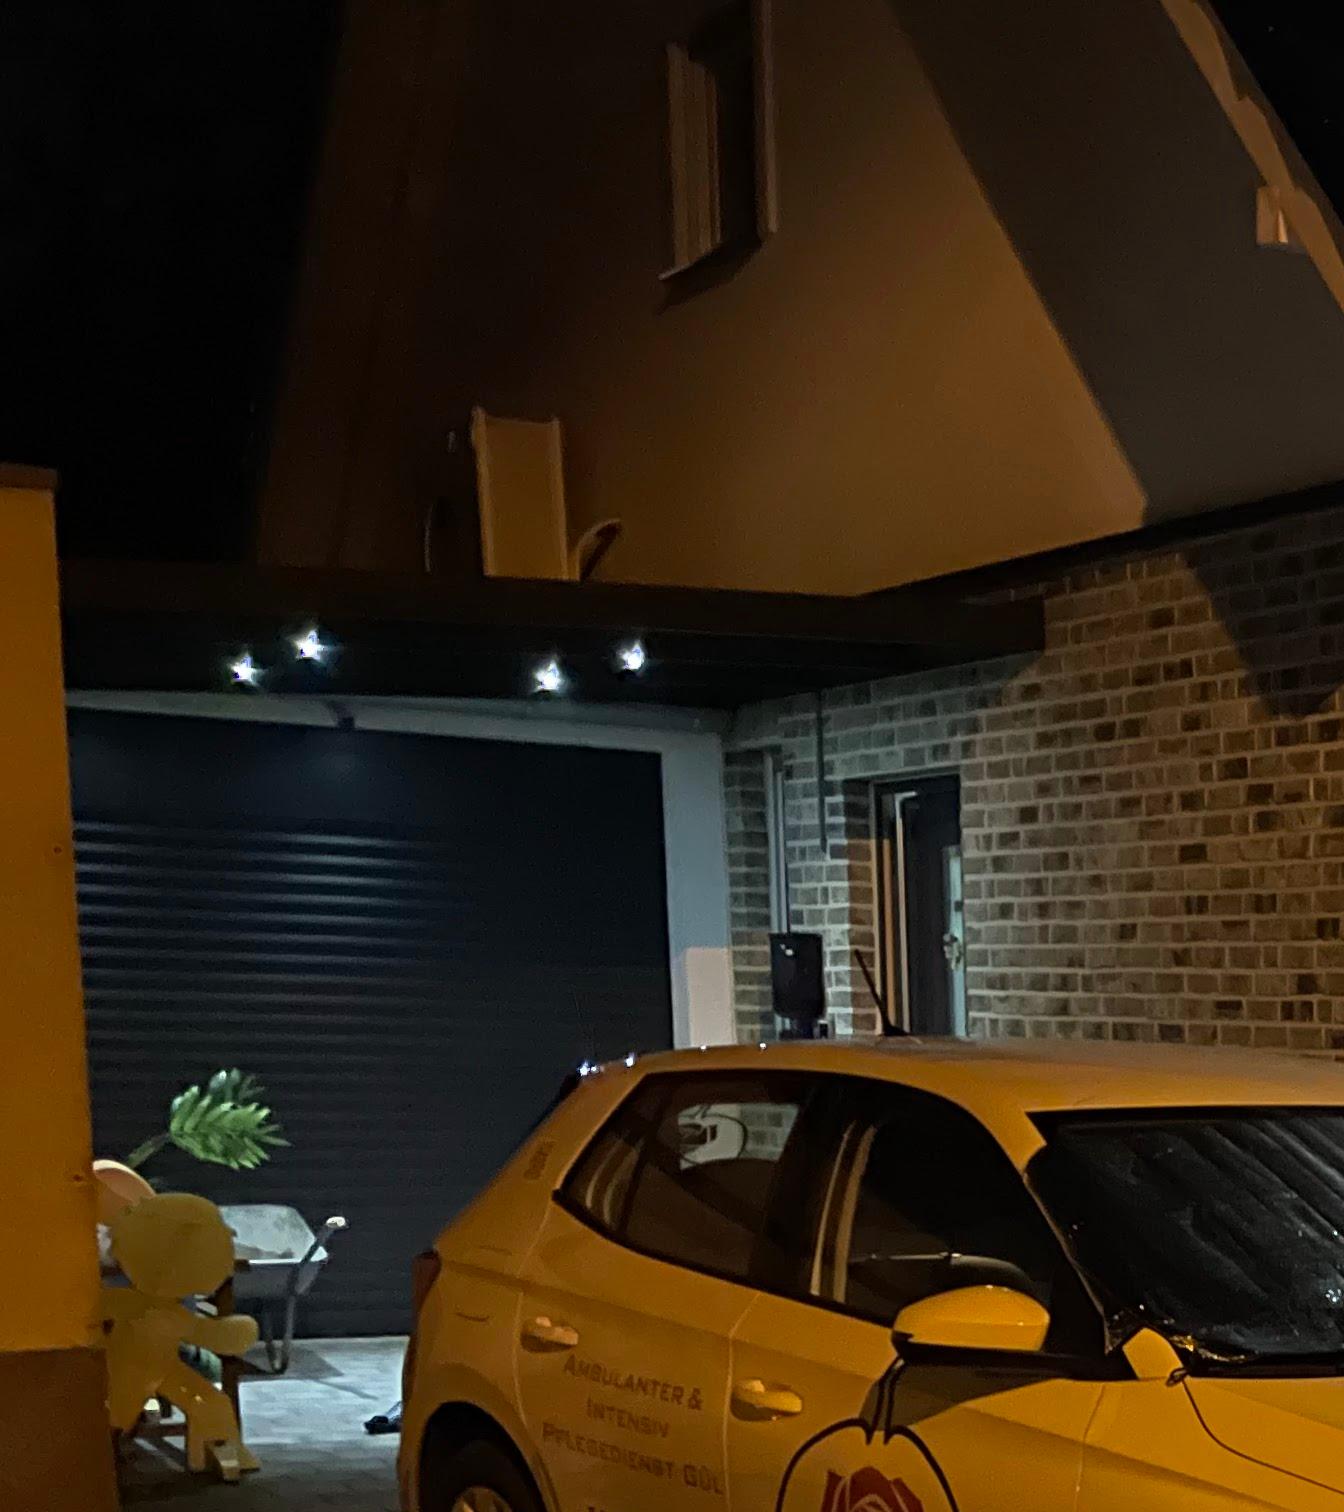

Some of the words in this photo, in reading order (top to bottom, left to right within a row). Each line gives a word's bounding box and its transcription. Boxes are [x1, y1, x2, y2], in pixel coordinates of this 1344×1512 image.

[563, 1354, 684, 1406] AMBULANTER
[687, 1387, 702, 1411] &
[586, 1398, 670, 1438] INTENSIV
[542, 1422, 675, 1481] PFLEGEDIENST
